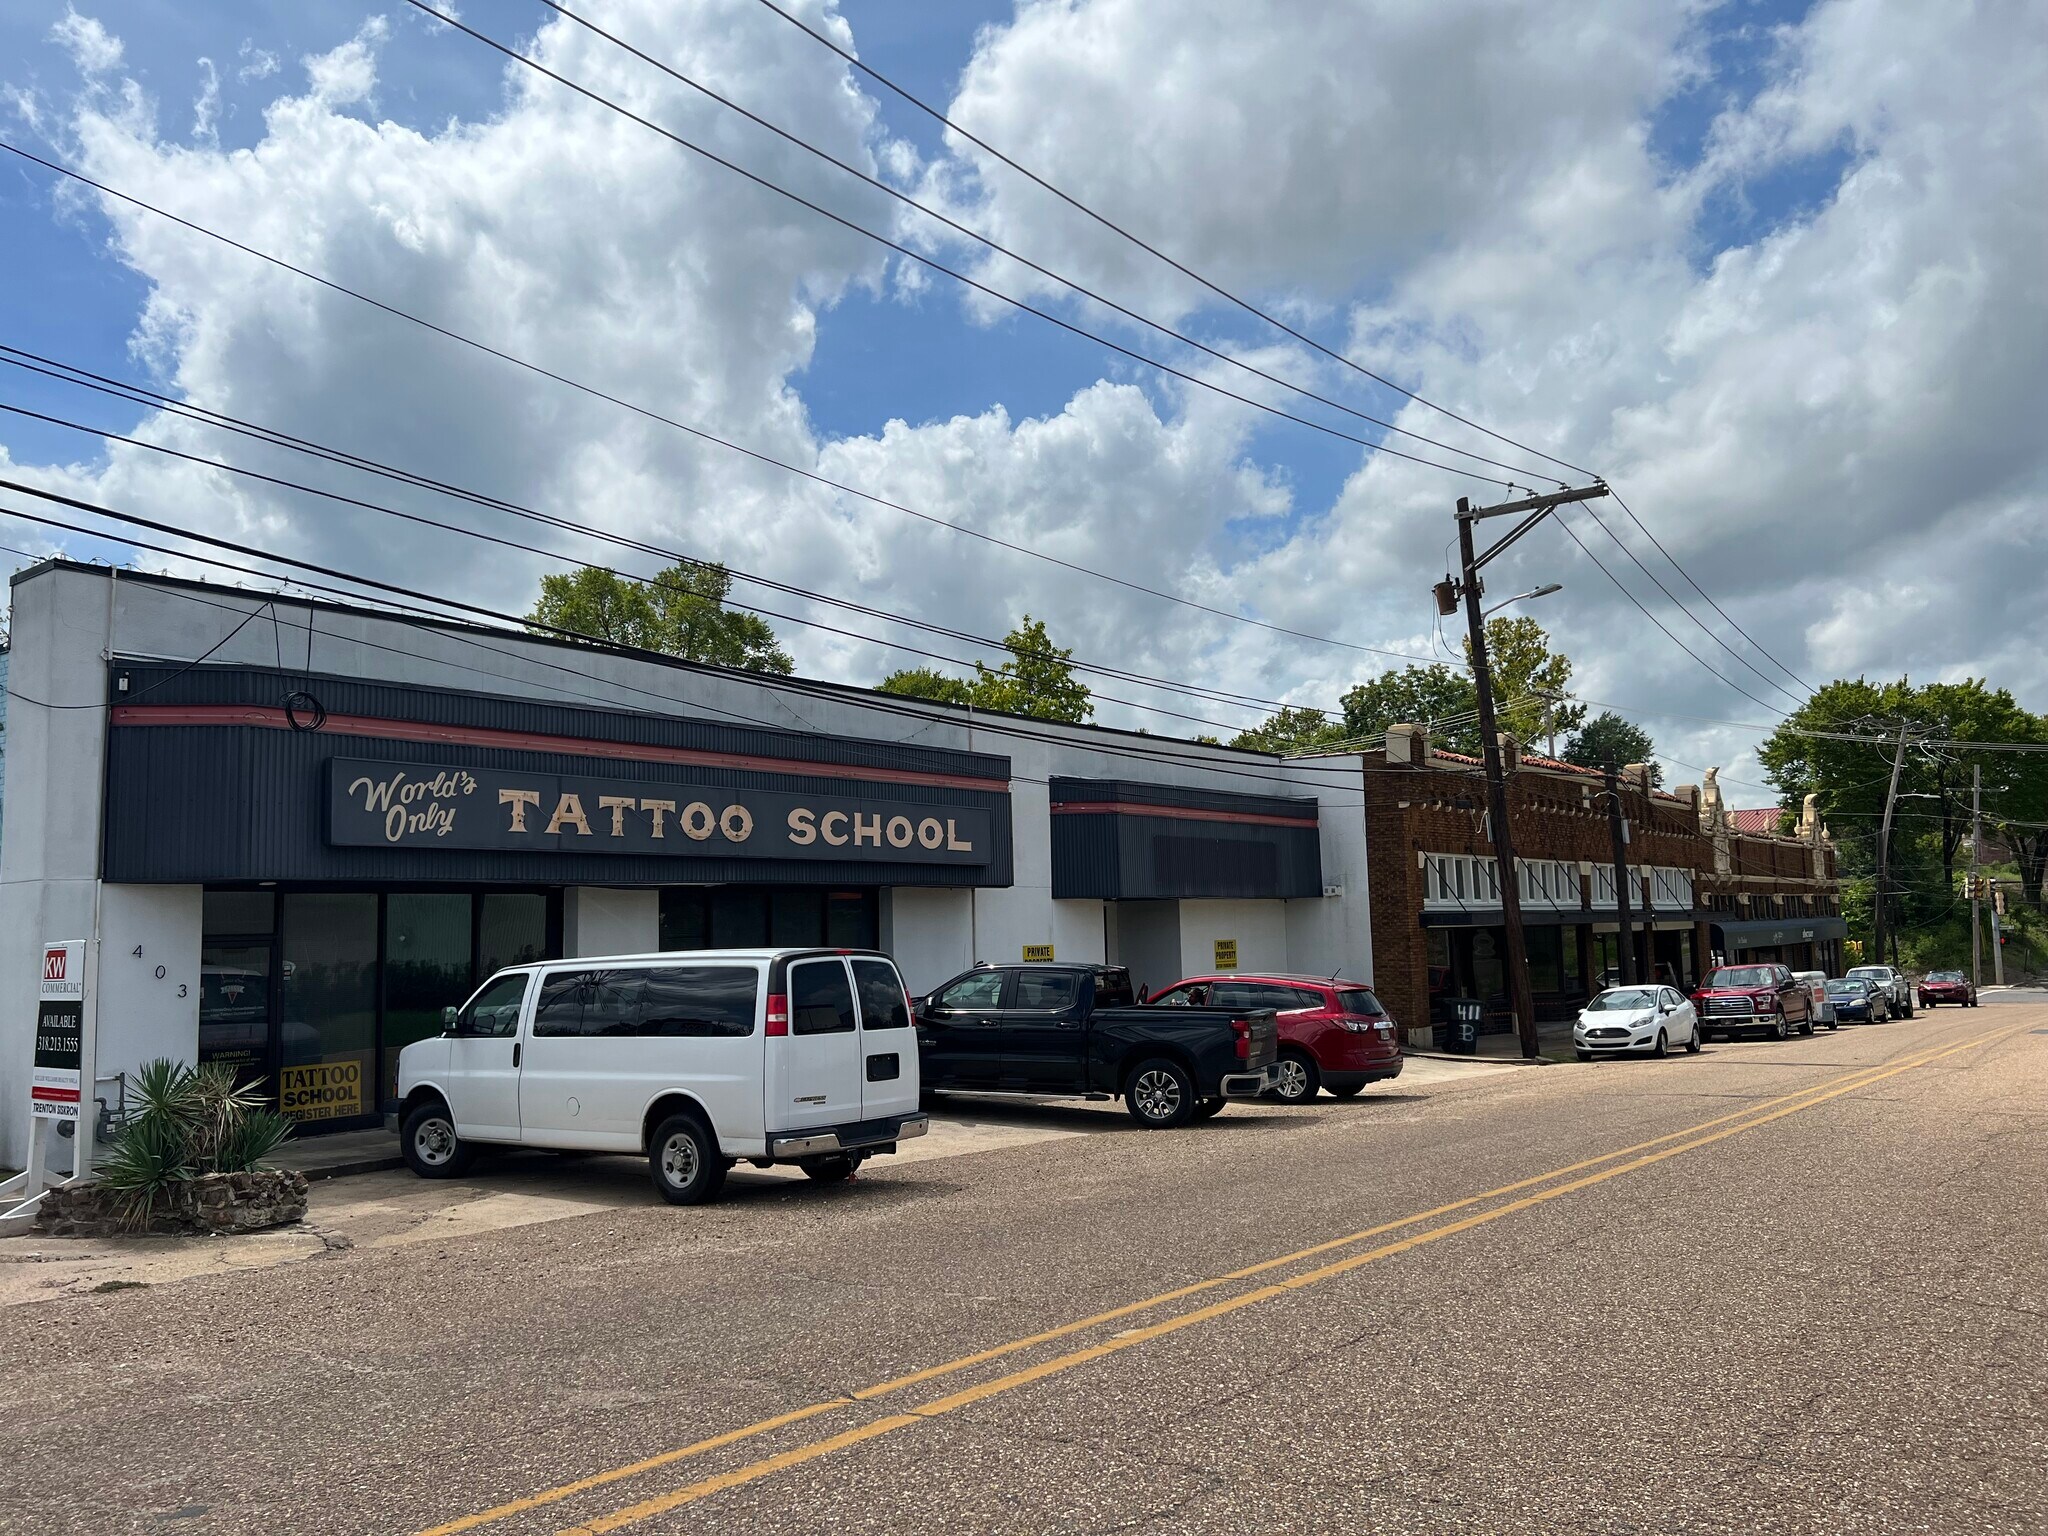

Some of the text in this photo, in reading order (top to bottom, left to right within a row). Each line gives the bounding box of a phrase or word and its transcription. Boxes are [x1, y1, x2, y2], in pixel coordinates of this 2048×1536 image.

[348, 771, 477, 812] World's
[385, 802, 456, 841] Only
[498, 788, 972, 851] TATTOO SCHOOL
[1027, 946, 1050, 956] PRIVATE
[1217, 941, 1234, 950] PRIVATE
[1215, 951, 1236, 960] PROPERTY
[45, 956, 66, 978] KW
[41, 982, 80, 993] COMMERCIAL
[1457, 1004, 1480, 1020] 411
[42, 1014, 76, 1028] AVAILABLE
[1459, 1023, 1474, 1041] B
[37, 1036, 78, 1052] 318.213.1555
[212, 1049, 251, 1059] WARNING!
[281, 1065, 359, 1089] TATTOO
[283, 1086, 357, 1107] SCHOOL
[32, 1103, 56, 1115] TRENTON
[334, 1103, 359, 1116] HERE
